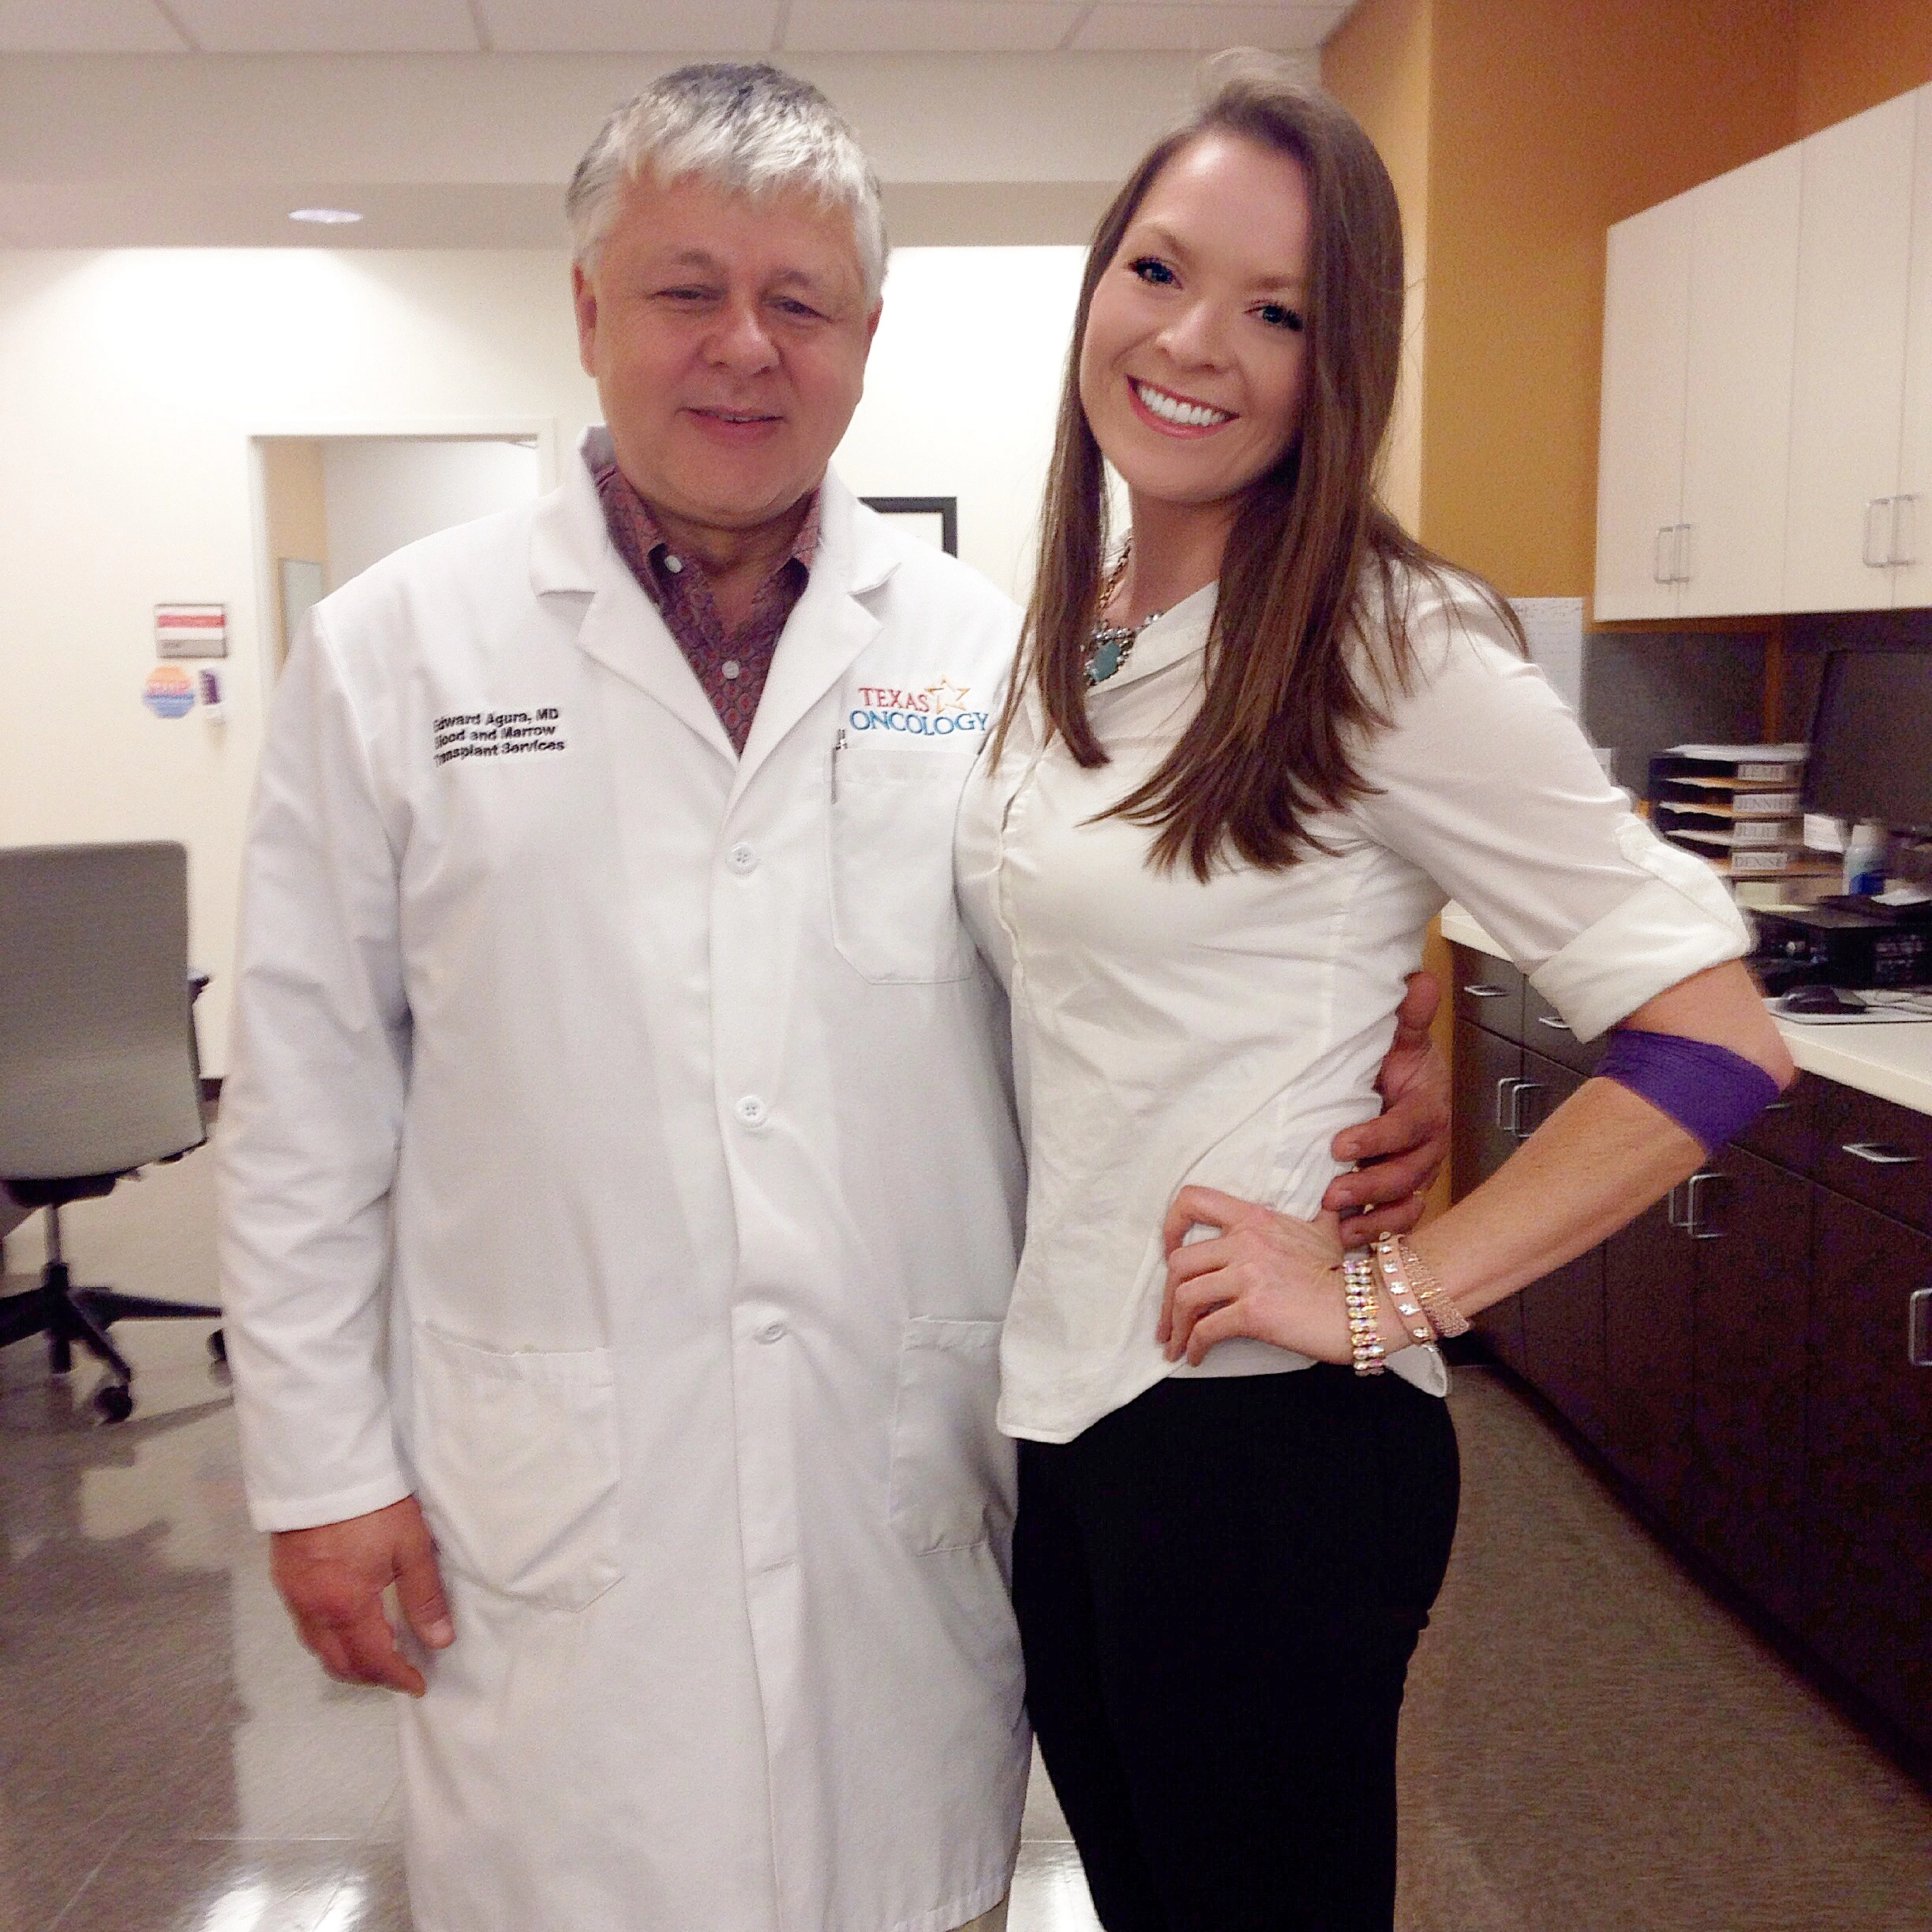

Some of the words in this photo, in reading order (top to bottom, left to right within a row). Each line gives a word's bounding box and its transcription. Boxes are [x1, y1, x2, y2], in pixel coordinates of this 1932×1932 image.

[857, 687, 930, 713] TEXAS
[485, 713, 532, 728] Agura,
[536, 708, 559, 721] MD
[849, 710, 989, 736] ONCOLOGY
[469, 728, 496, 741] and
[501, 725, 556, 739] Marrow
[501, 739, 565, 754] Services
[1735, 796, 1799, 810] JENNIFE
